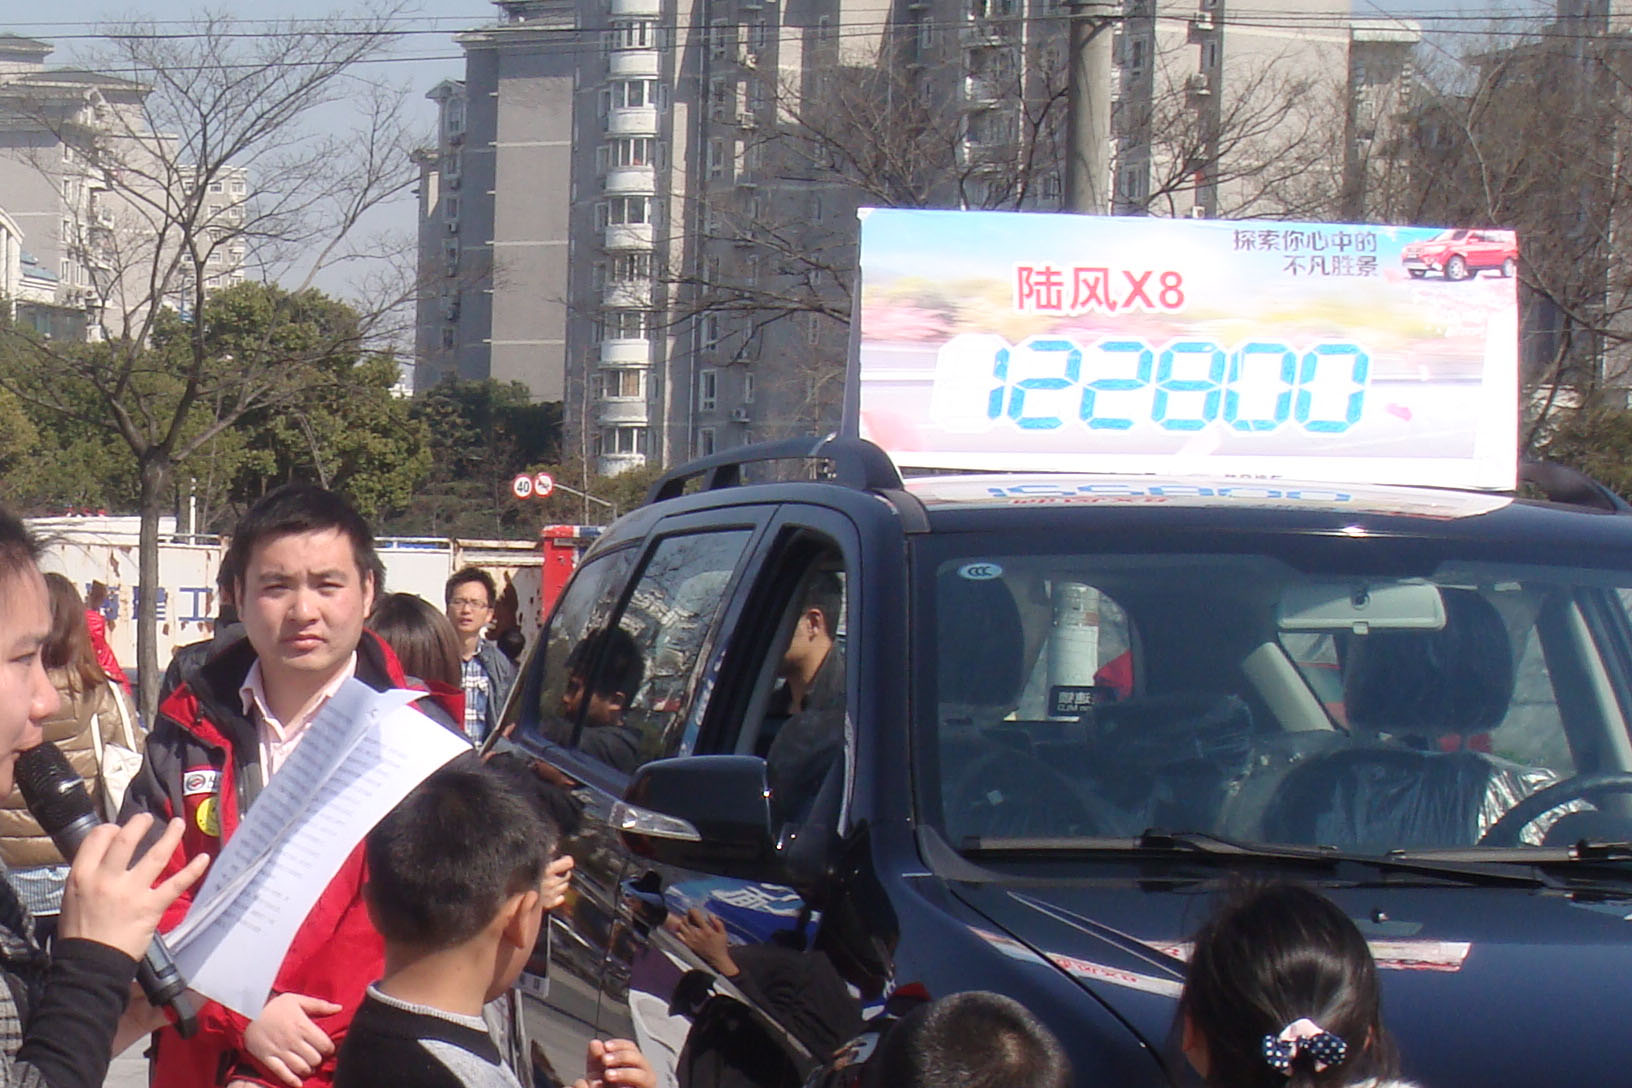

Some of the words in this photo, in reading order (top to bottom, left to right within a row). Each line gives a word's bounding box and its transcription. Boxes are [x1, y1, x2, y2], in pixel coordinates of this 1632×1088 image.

[1234, 229, 1377, 252] 探索你心中的
[1283, 255, 1378, 277] 不凡胜景
[1017, 266, 1185, 312] 陆风X8
[987, 340, 1369, 433] 122800
[516, 481, 530, 493] 40
